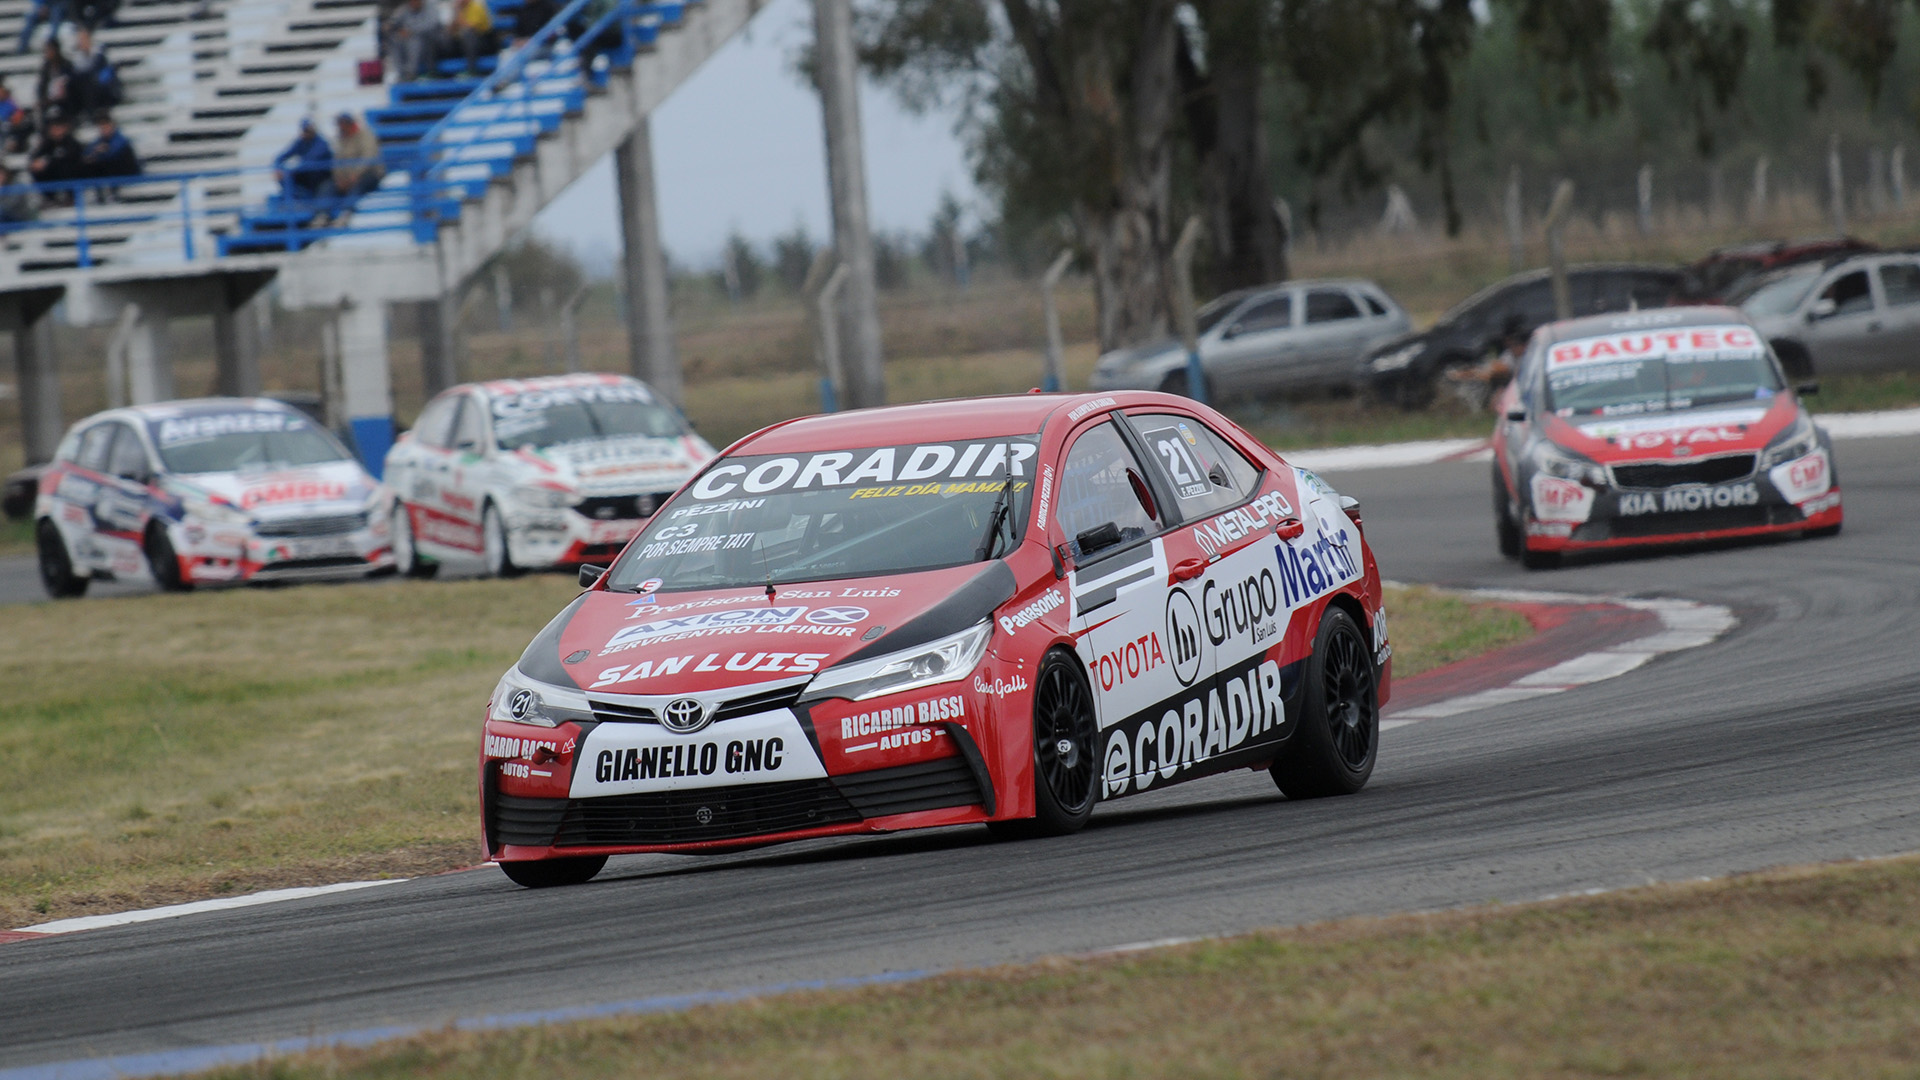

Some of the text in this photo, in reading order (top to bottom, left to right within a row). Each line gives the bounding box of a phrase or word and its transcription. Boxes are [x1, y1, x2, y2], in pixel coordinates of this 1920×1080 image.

[1552, 329, 1754, 363] BAUTEC
[1616, 427, 1745, 451] TOTAL
[692, 443, 1037, 500] CORADIR
[1157, 437, 1202, 485] 21
[850, 486, 909, 500] FELIZ
[904, 482, 941, 496] DÍA
[1619, 482, 1759, 516] KIA MOTORS
[671, 498, 766, 519] PEZZINI
[1202, 490, 1294, 547] METALPRO
[638, 532, 755, 560] POR SIEMPRE TATI
[654, 522, 699, 541] C3
[1203, 518, 1358, 646] Grupo Martin
[624, 587, 902, 620] Previsora San Luis
[999, 587, 1065, 636] Panasonic
[614, 608, 799, 640] AXION
[708, 616, 790, 627] energy
[1256, 620, 1277, 642] San Luis
[598, 625, 857, 656] SERVICENTRO LAFINUR
[589, 652, 830, 688] SAN LUIS
[1089, 631, 1166, 693] TOYOTA
[995, 674, 1028, 699] Galli
[511, 694, 530, 713] 21
[841, 695, 965, 740] RICARDO BASSI
[880, 728, 932, 750] AUTOS
[503, 762, 529, 778] AUTOS
[595, 737, 783, 783] GIANELLO GNC
